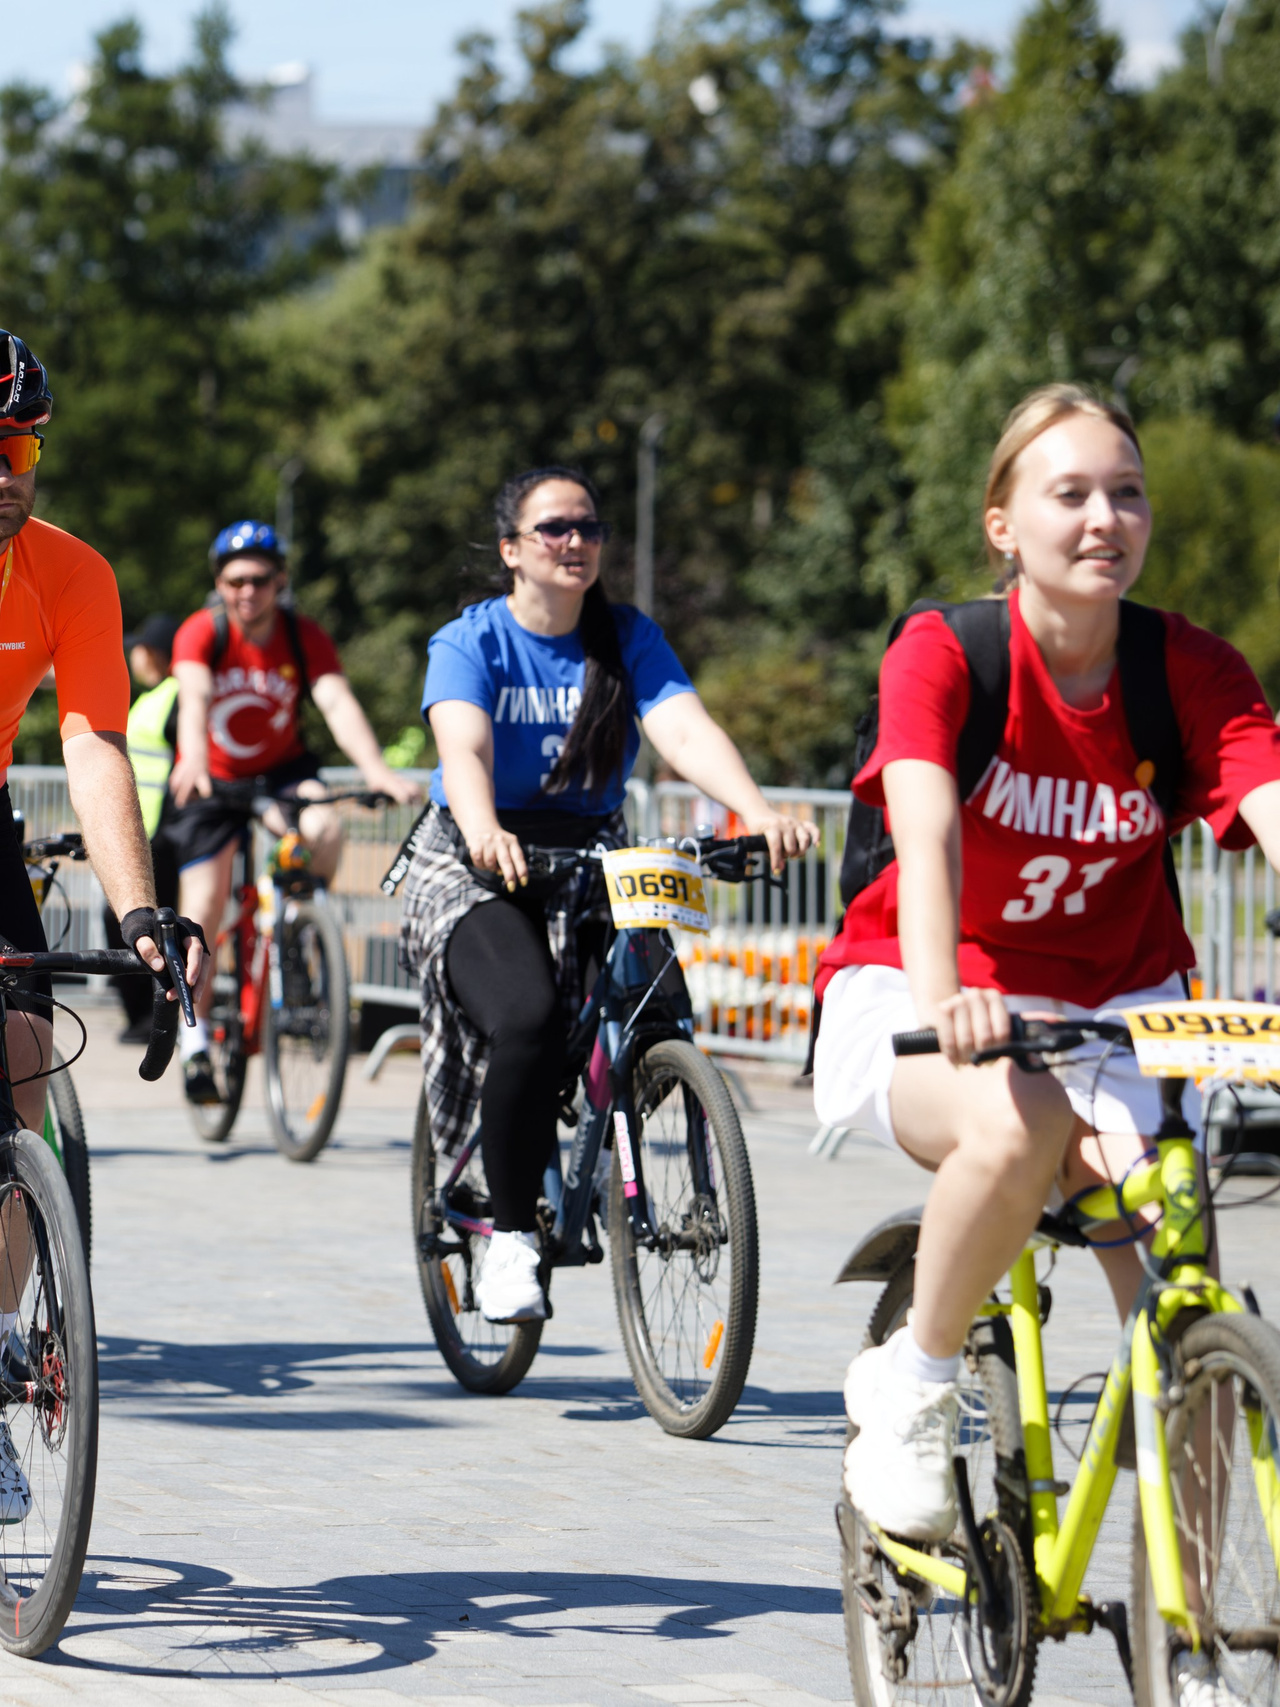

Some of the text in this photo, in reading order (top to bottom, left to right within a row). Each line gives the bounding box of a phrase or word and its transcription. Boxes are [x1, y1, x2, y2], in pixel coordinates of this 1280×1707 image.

[615, 873, 689, 903] 0691
[1001, 855, 1118, 923] 31
[173, 960, 191, 1012] ULTEGRA
